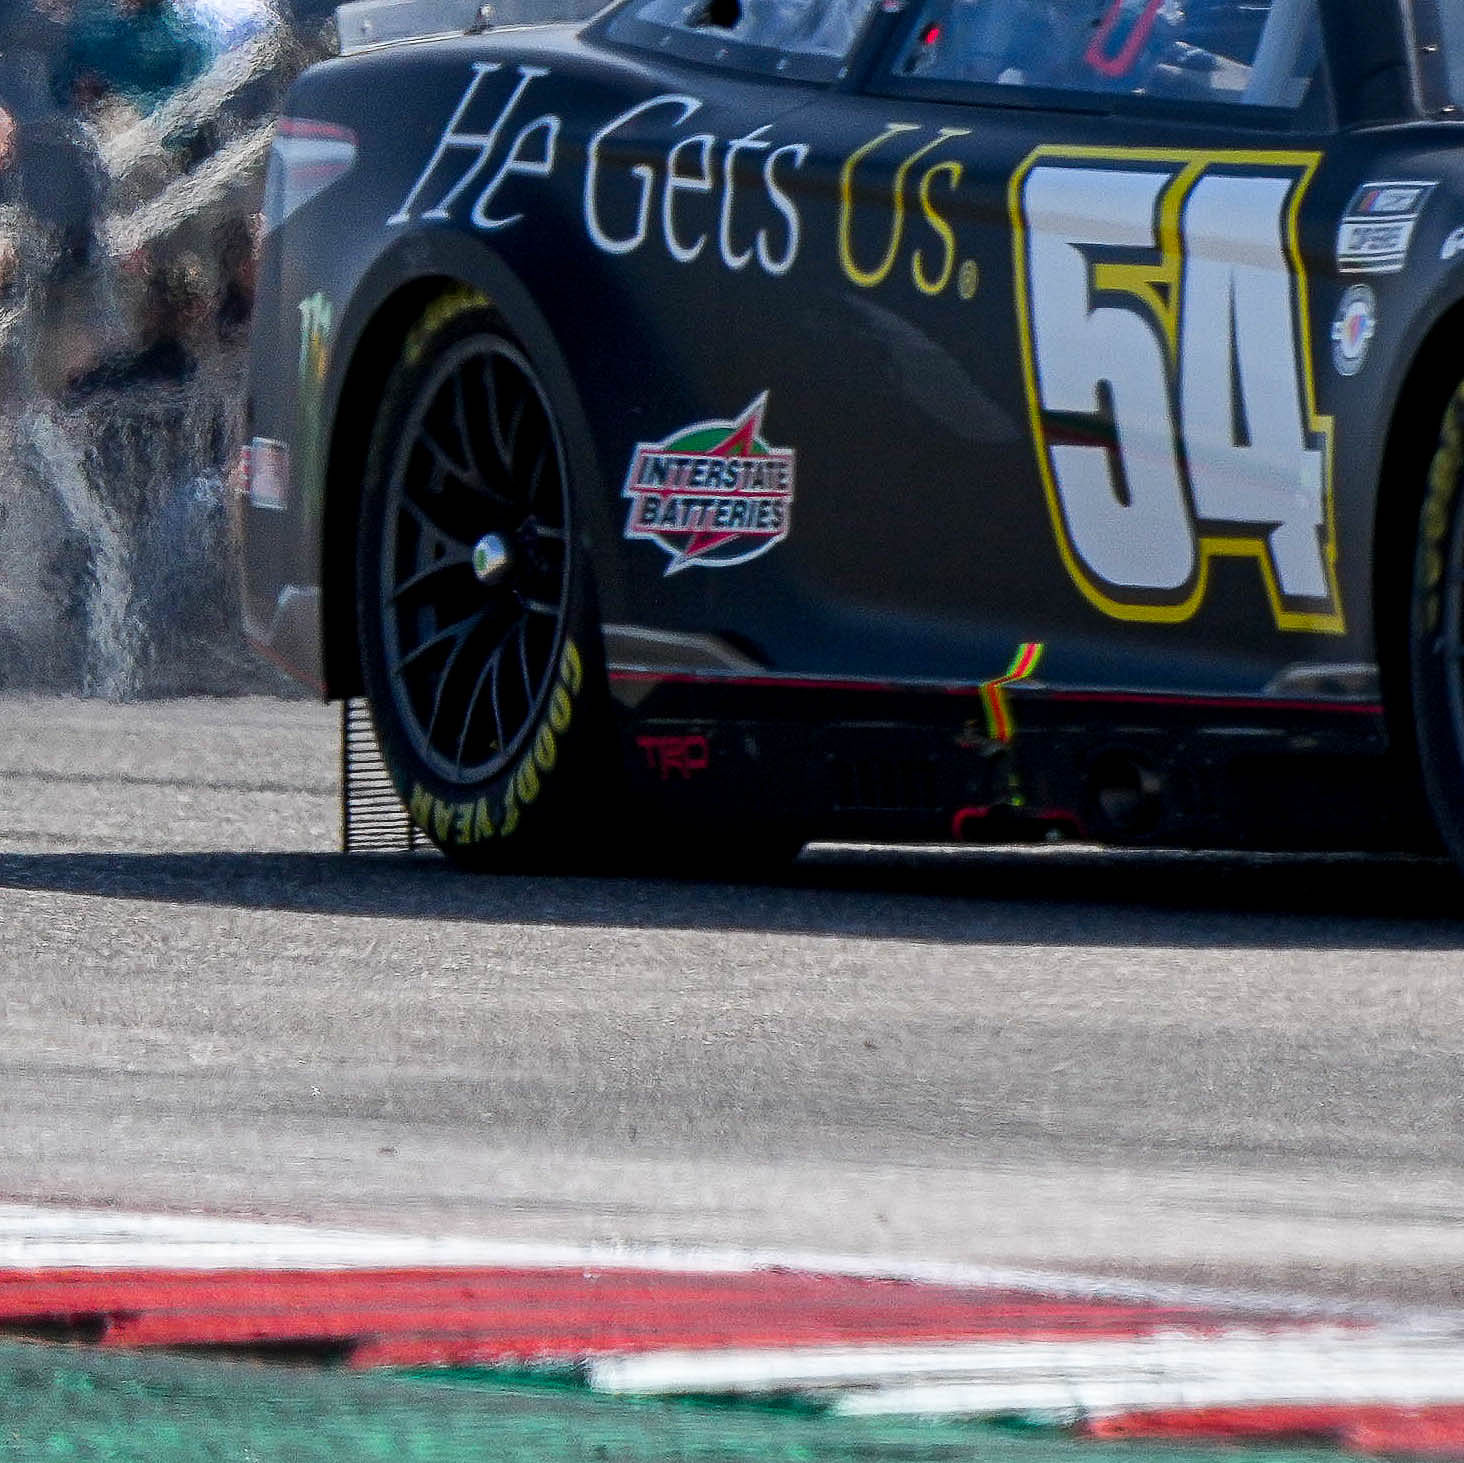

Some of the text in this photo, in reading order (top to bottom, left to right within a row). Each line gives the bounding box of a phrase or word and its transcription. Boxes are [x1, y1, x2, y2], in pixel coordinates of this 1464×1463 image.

[387, 61, 561, 231] He
[582, 93, 809, 277] Gets
[636, 453, 791, 491] INTERSTATE
[1014, 151, 1338, 624] 54
[639, 493, 788, 530] BATTERIES
[409, 638, 582, 845] GOODYEAR
